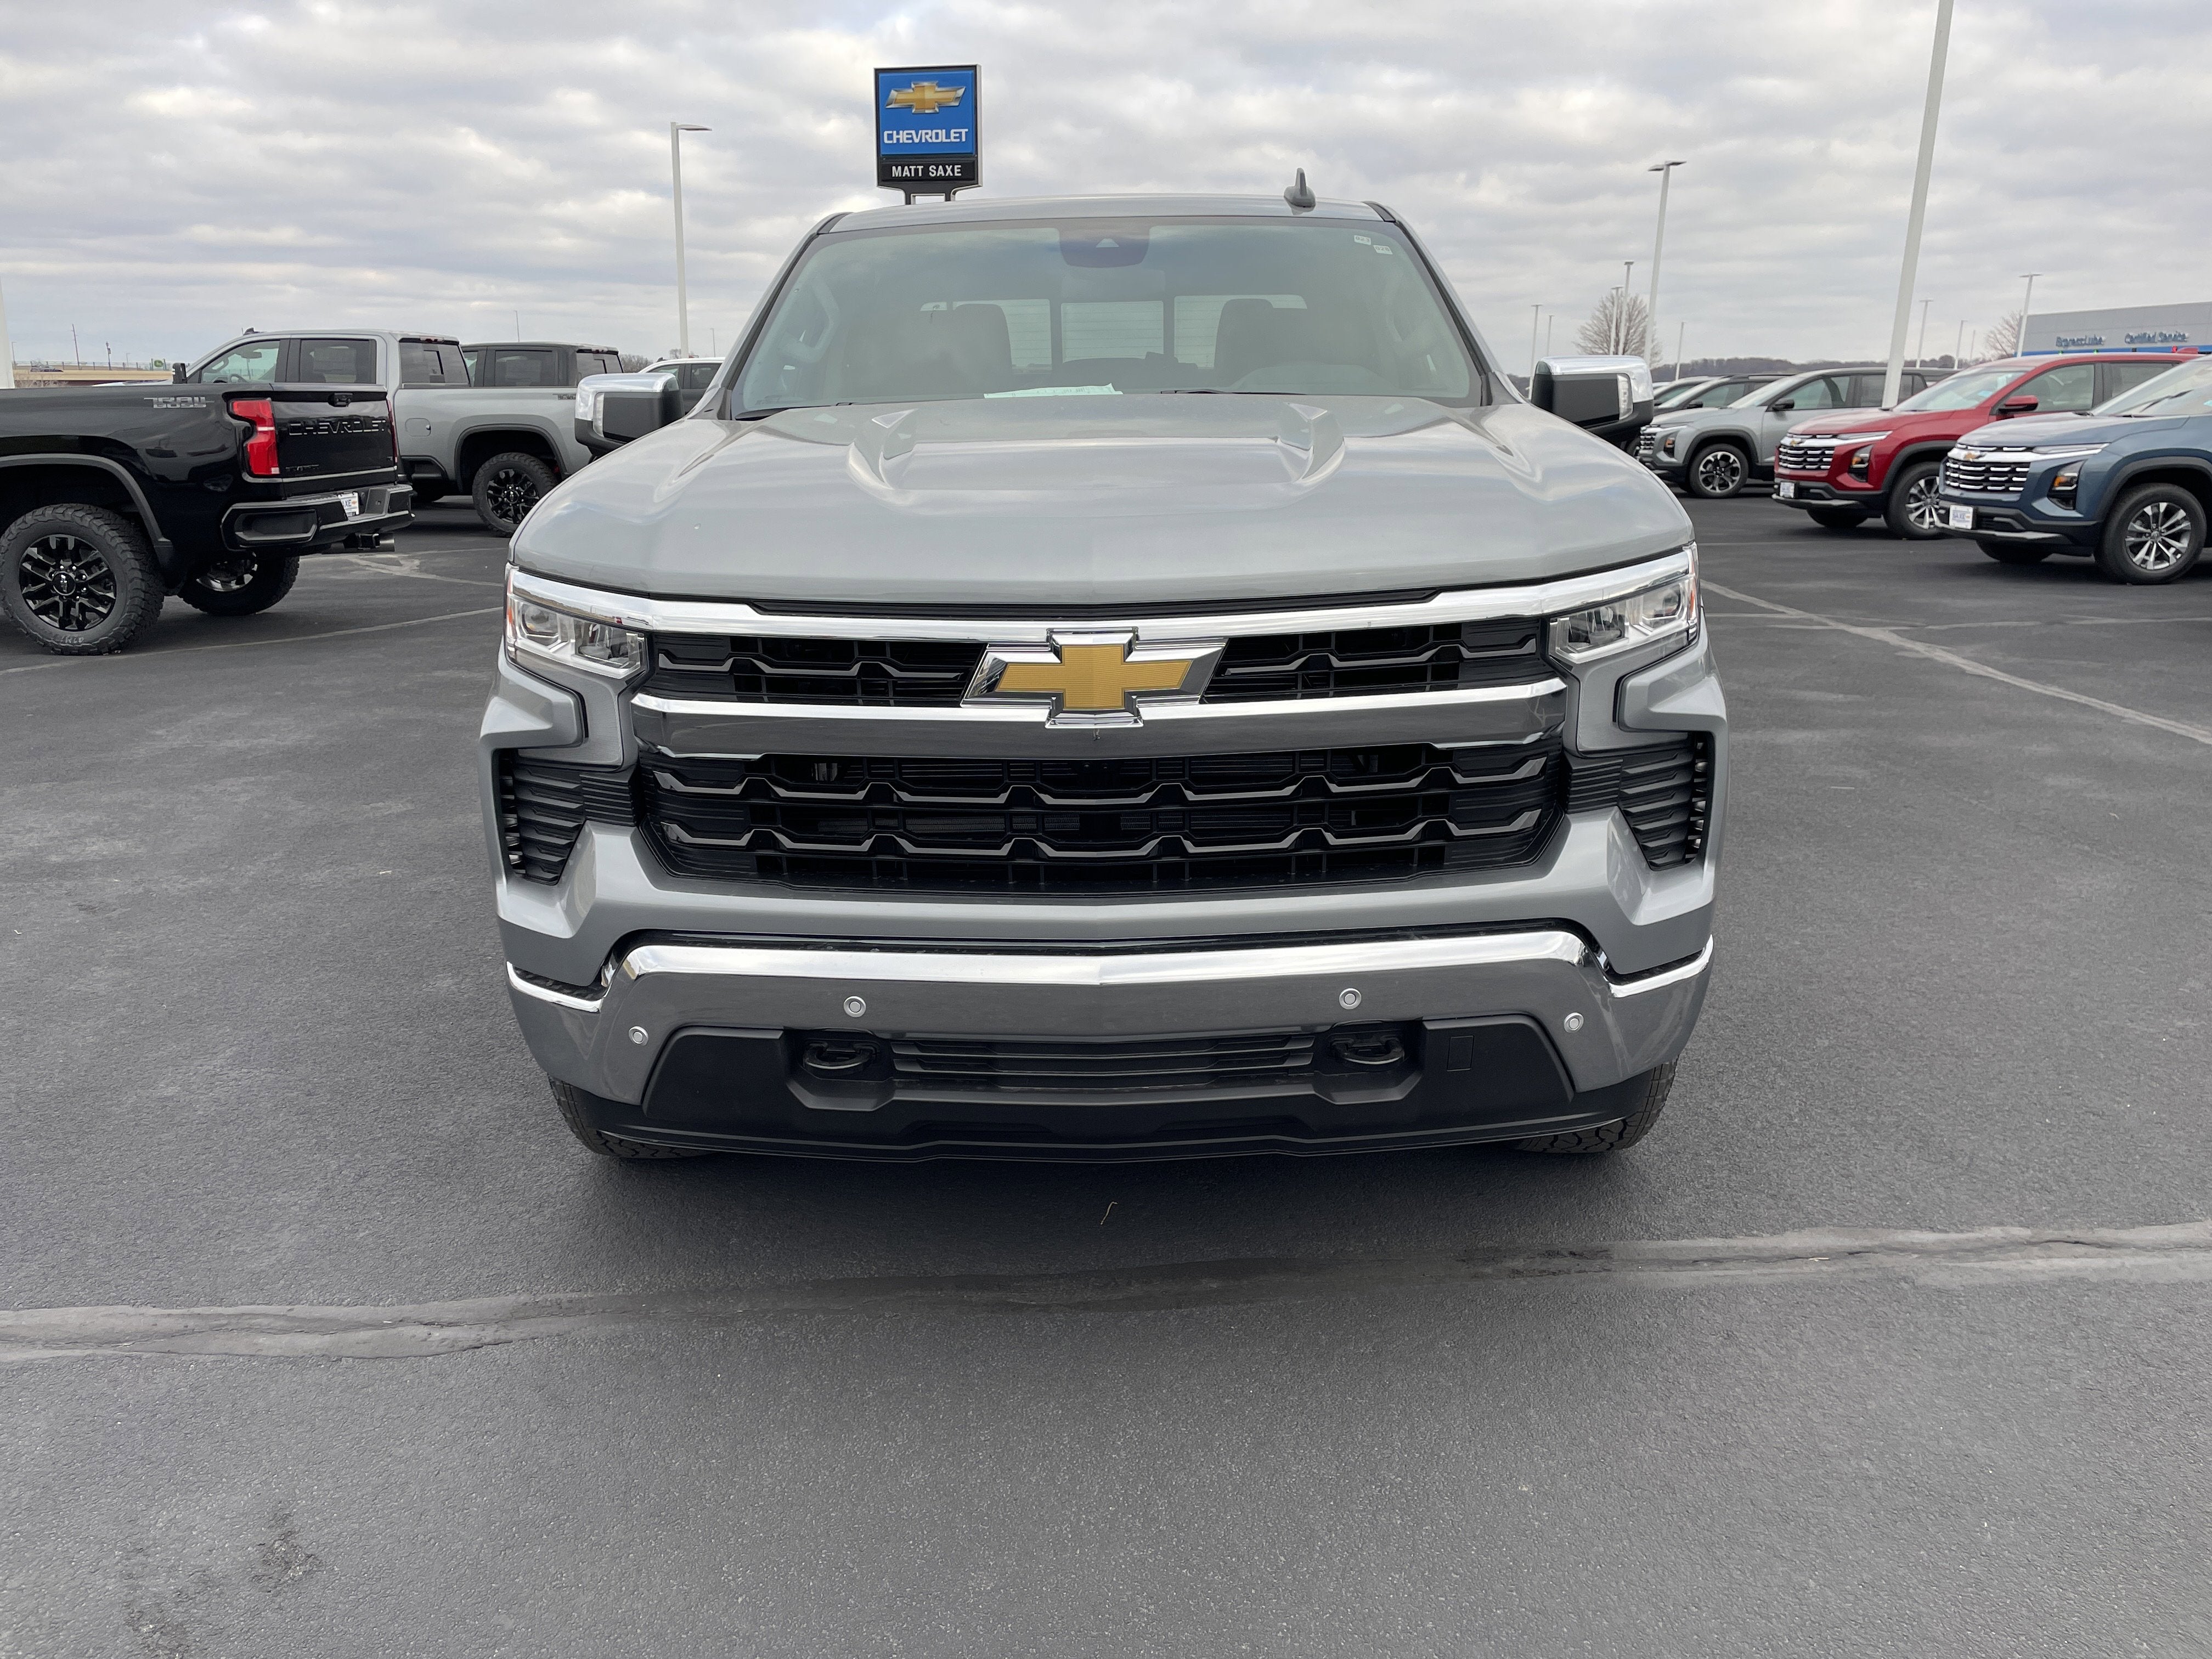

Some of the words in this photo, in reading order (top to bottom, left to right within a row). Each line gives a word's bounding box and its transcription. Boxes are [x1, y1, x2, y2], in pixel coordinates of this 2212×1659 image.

[883, 128, 969, 144] CHEVROLET
[891, 165, 924, 177] MATT
[929, 165, 962, 177] SAXE
[289, 420, 386, 436] CHEVROLET
